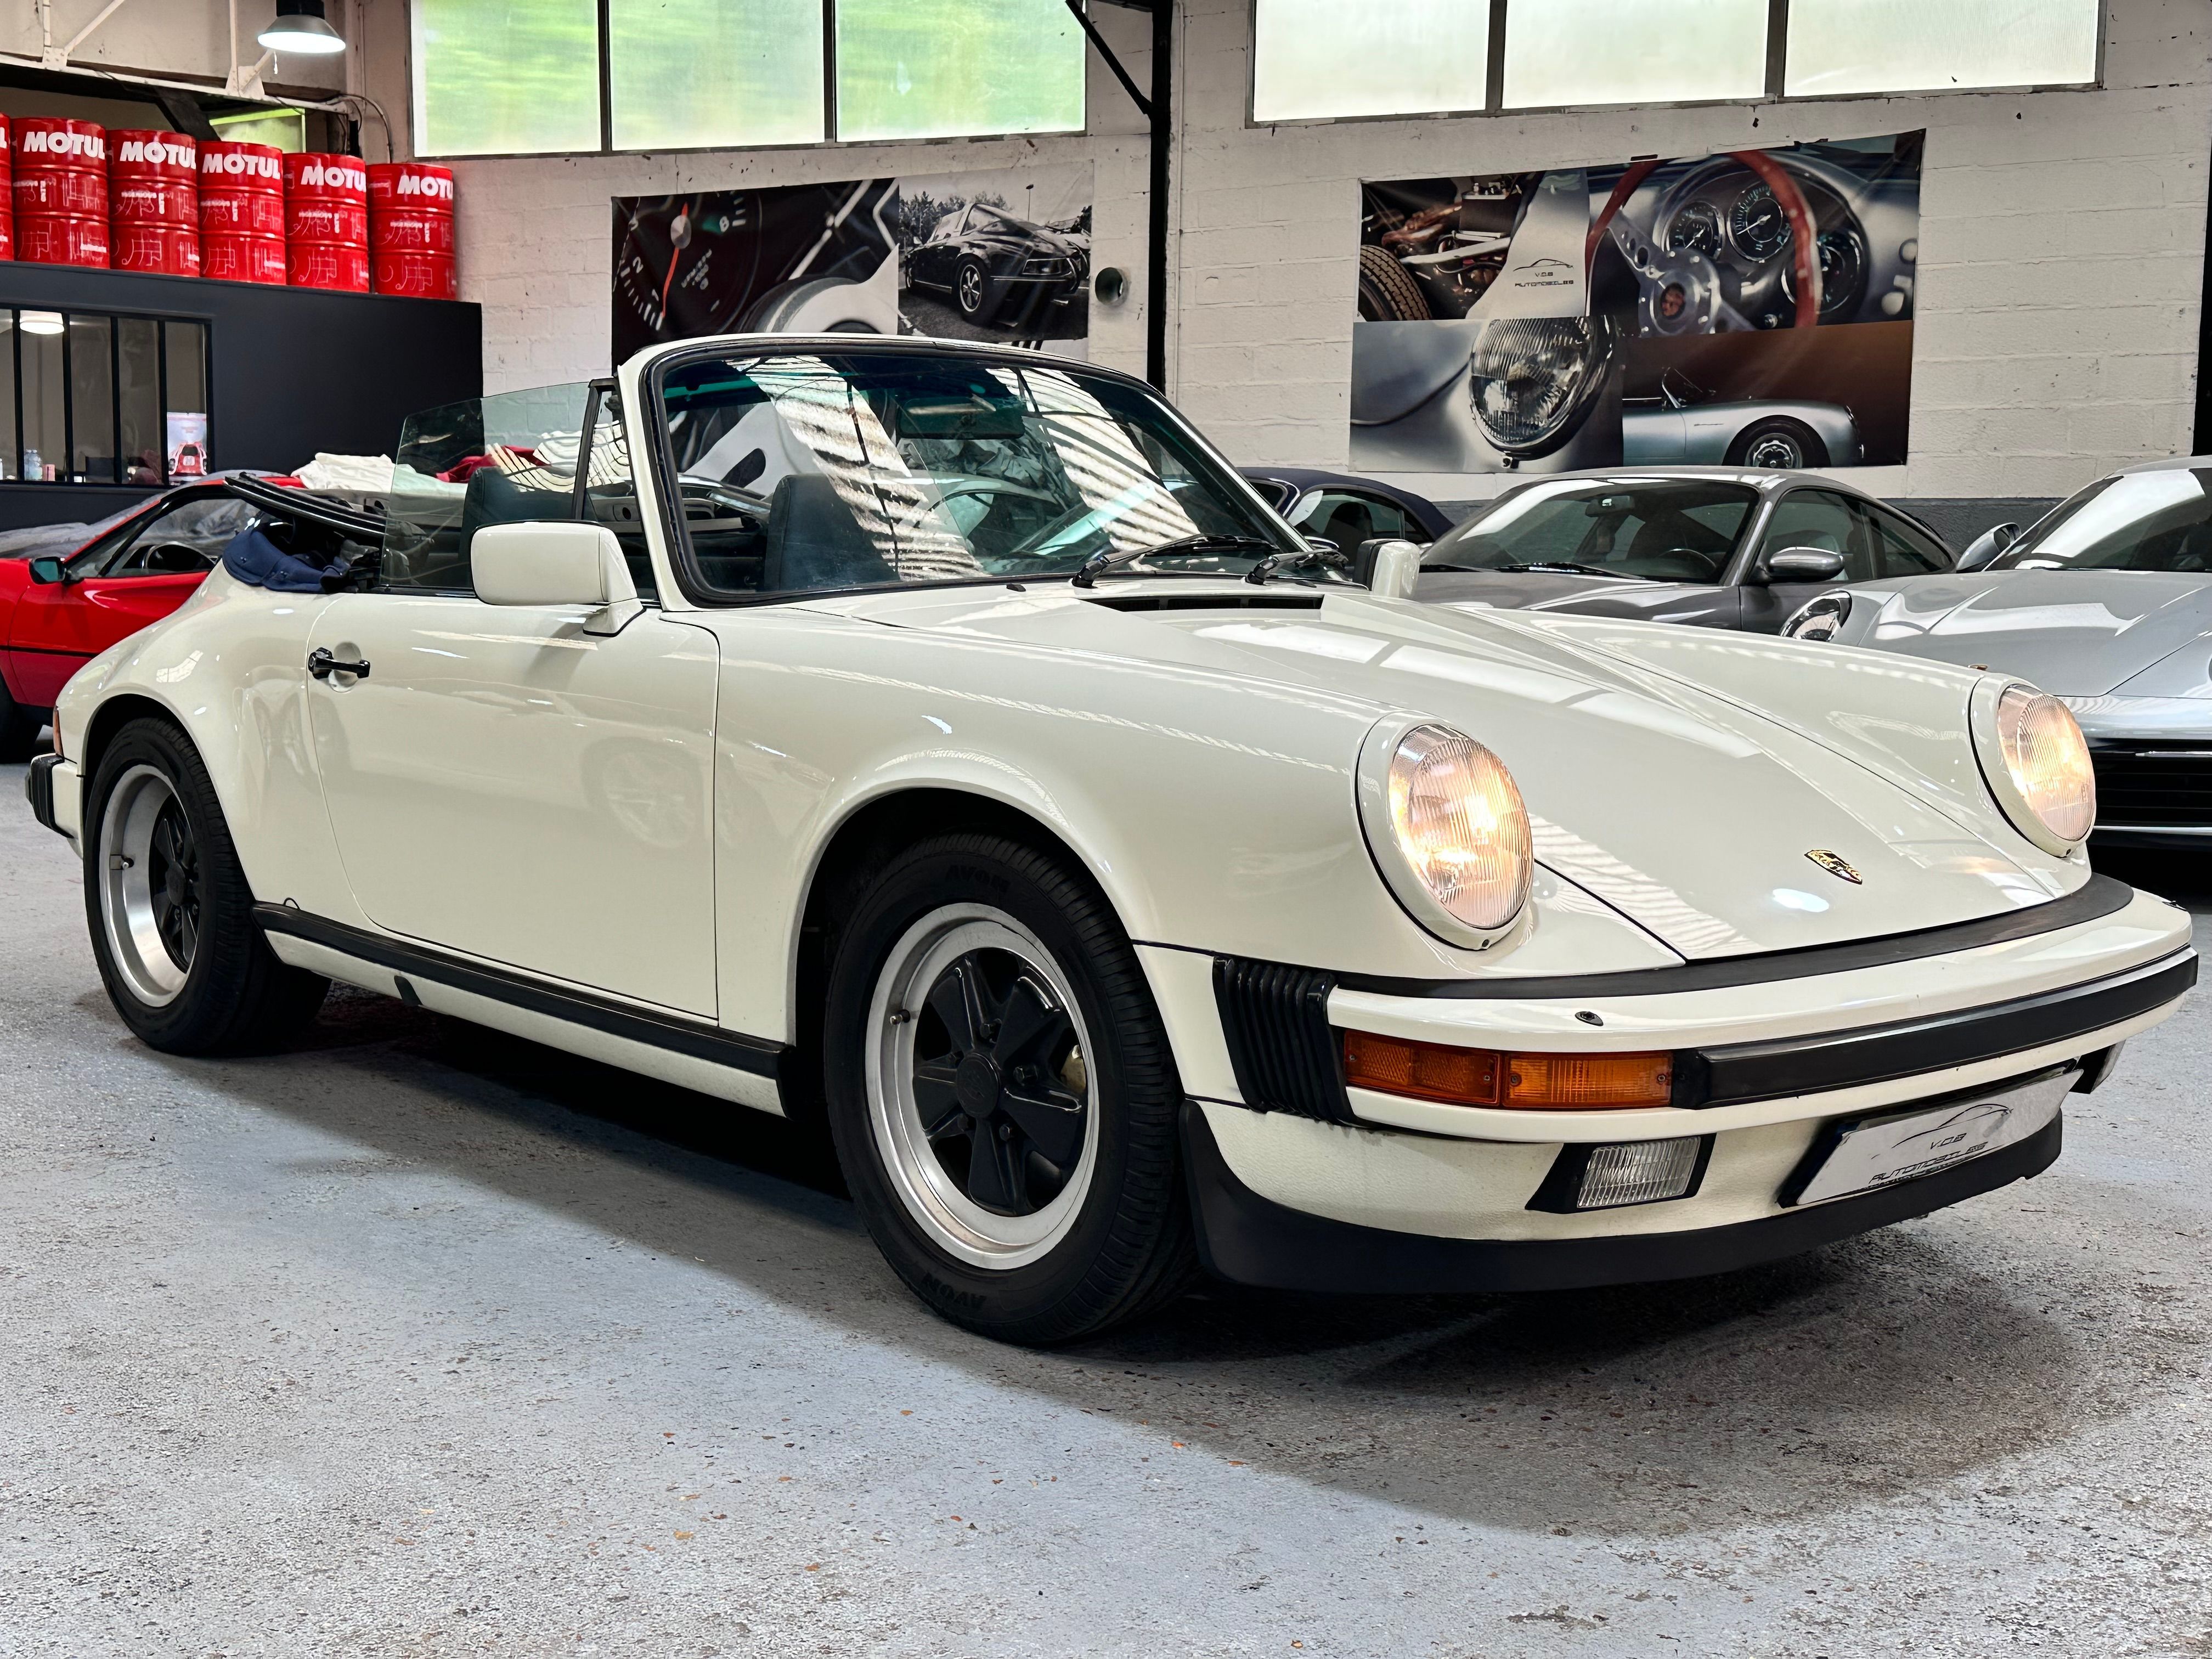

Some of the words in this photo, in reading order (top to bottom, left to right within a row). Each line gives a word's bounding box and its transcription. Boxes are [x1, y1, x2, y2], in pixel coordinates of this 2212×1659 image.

[23, 131, 105, 160] MOTUL
[120, 141, 196, 170] MOTUL
[202, 153, 280, 180] MOTUL
[300, 166, 366, 193] MOTU
[397, 174, 453, 200] MOTU
